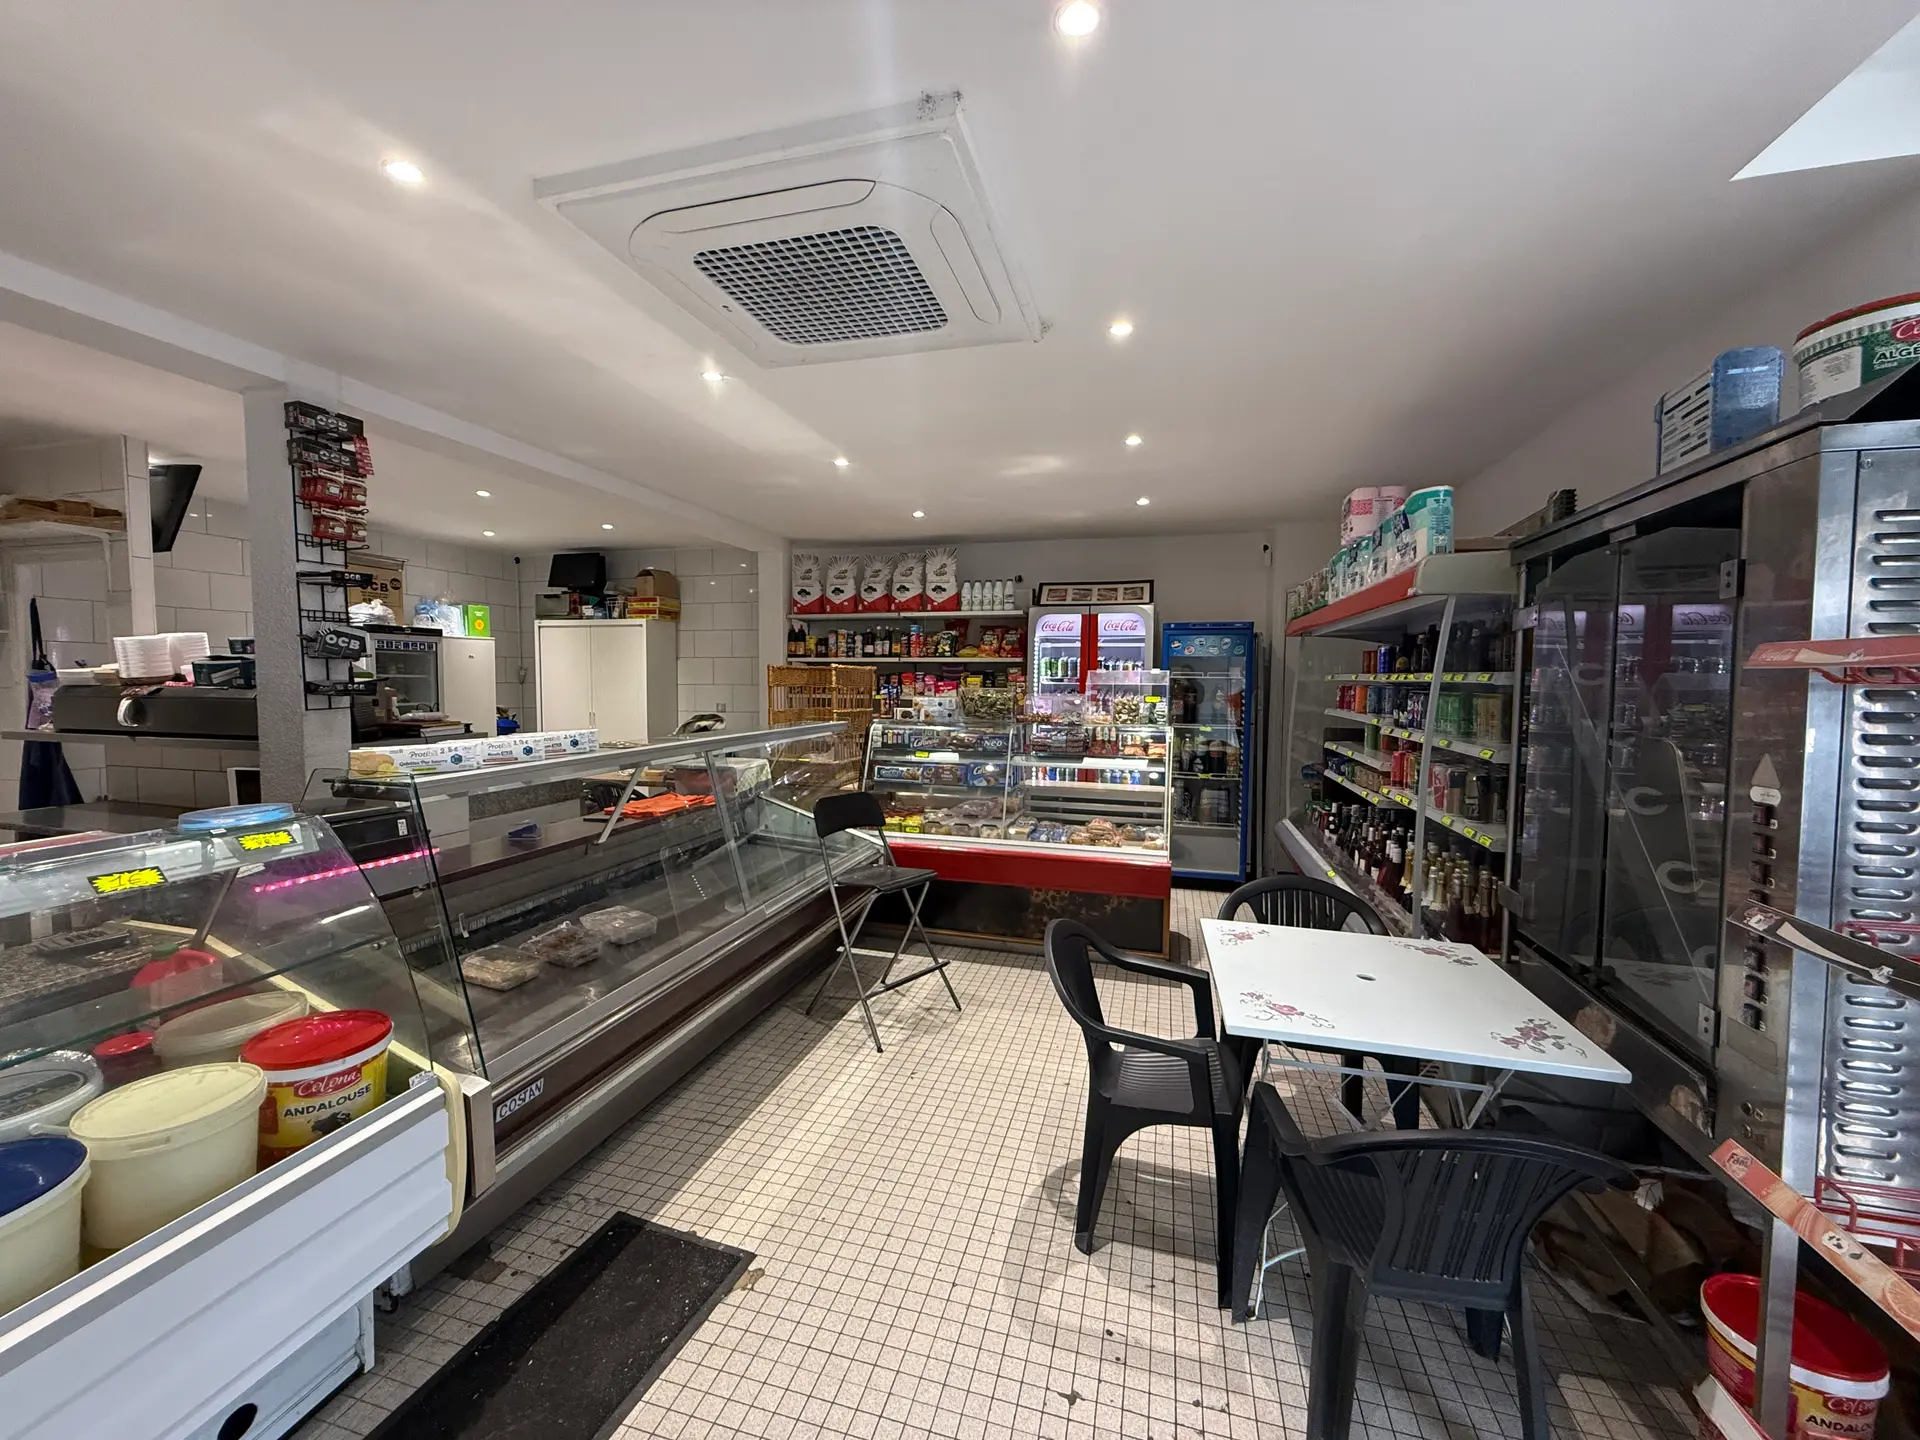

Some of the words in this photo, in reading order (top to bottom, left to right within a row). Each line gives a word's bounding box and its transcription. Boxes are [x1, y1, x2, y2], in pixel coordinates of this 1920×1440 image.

[316, 414, 348, 432] OCB
[319, 449, 350, 466] OCB
[344, 573, 361, 581] OCB
[325, 633, 361, 650] OCB
[294, 1071, 361, 1096] Colona
[283, 1083, 372, 1118] ANDALOUSE
[500, 1080, 542, 1118] COSTAN
